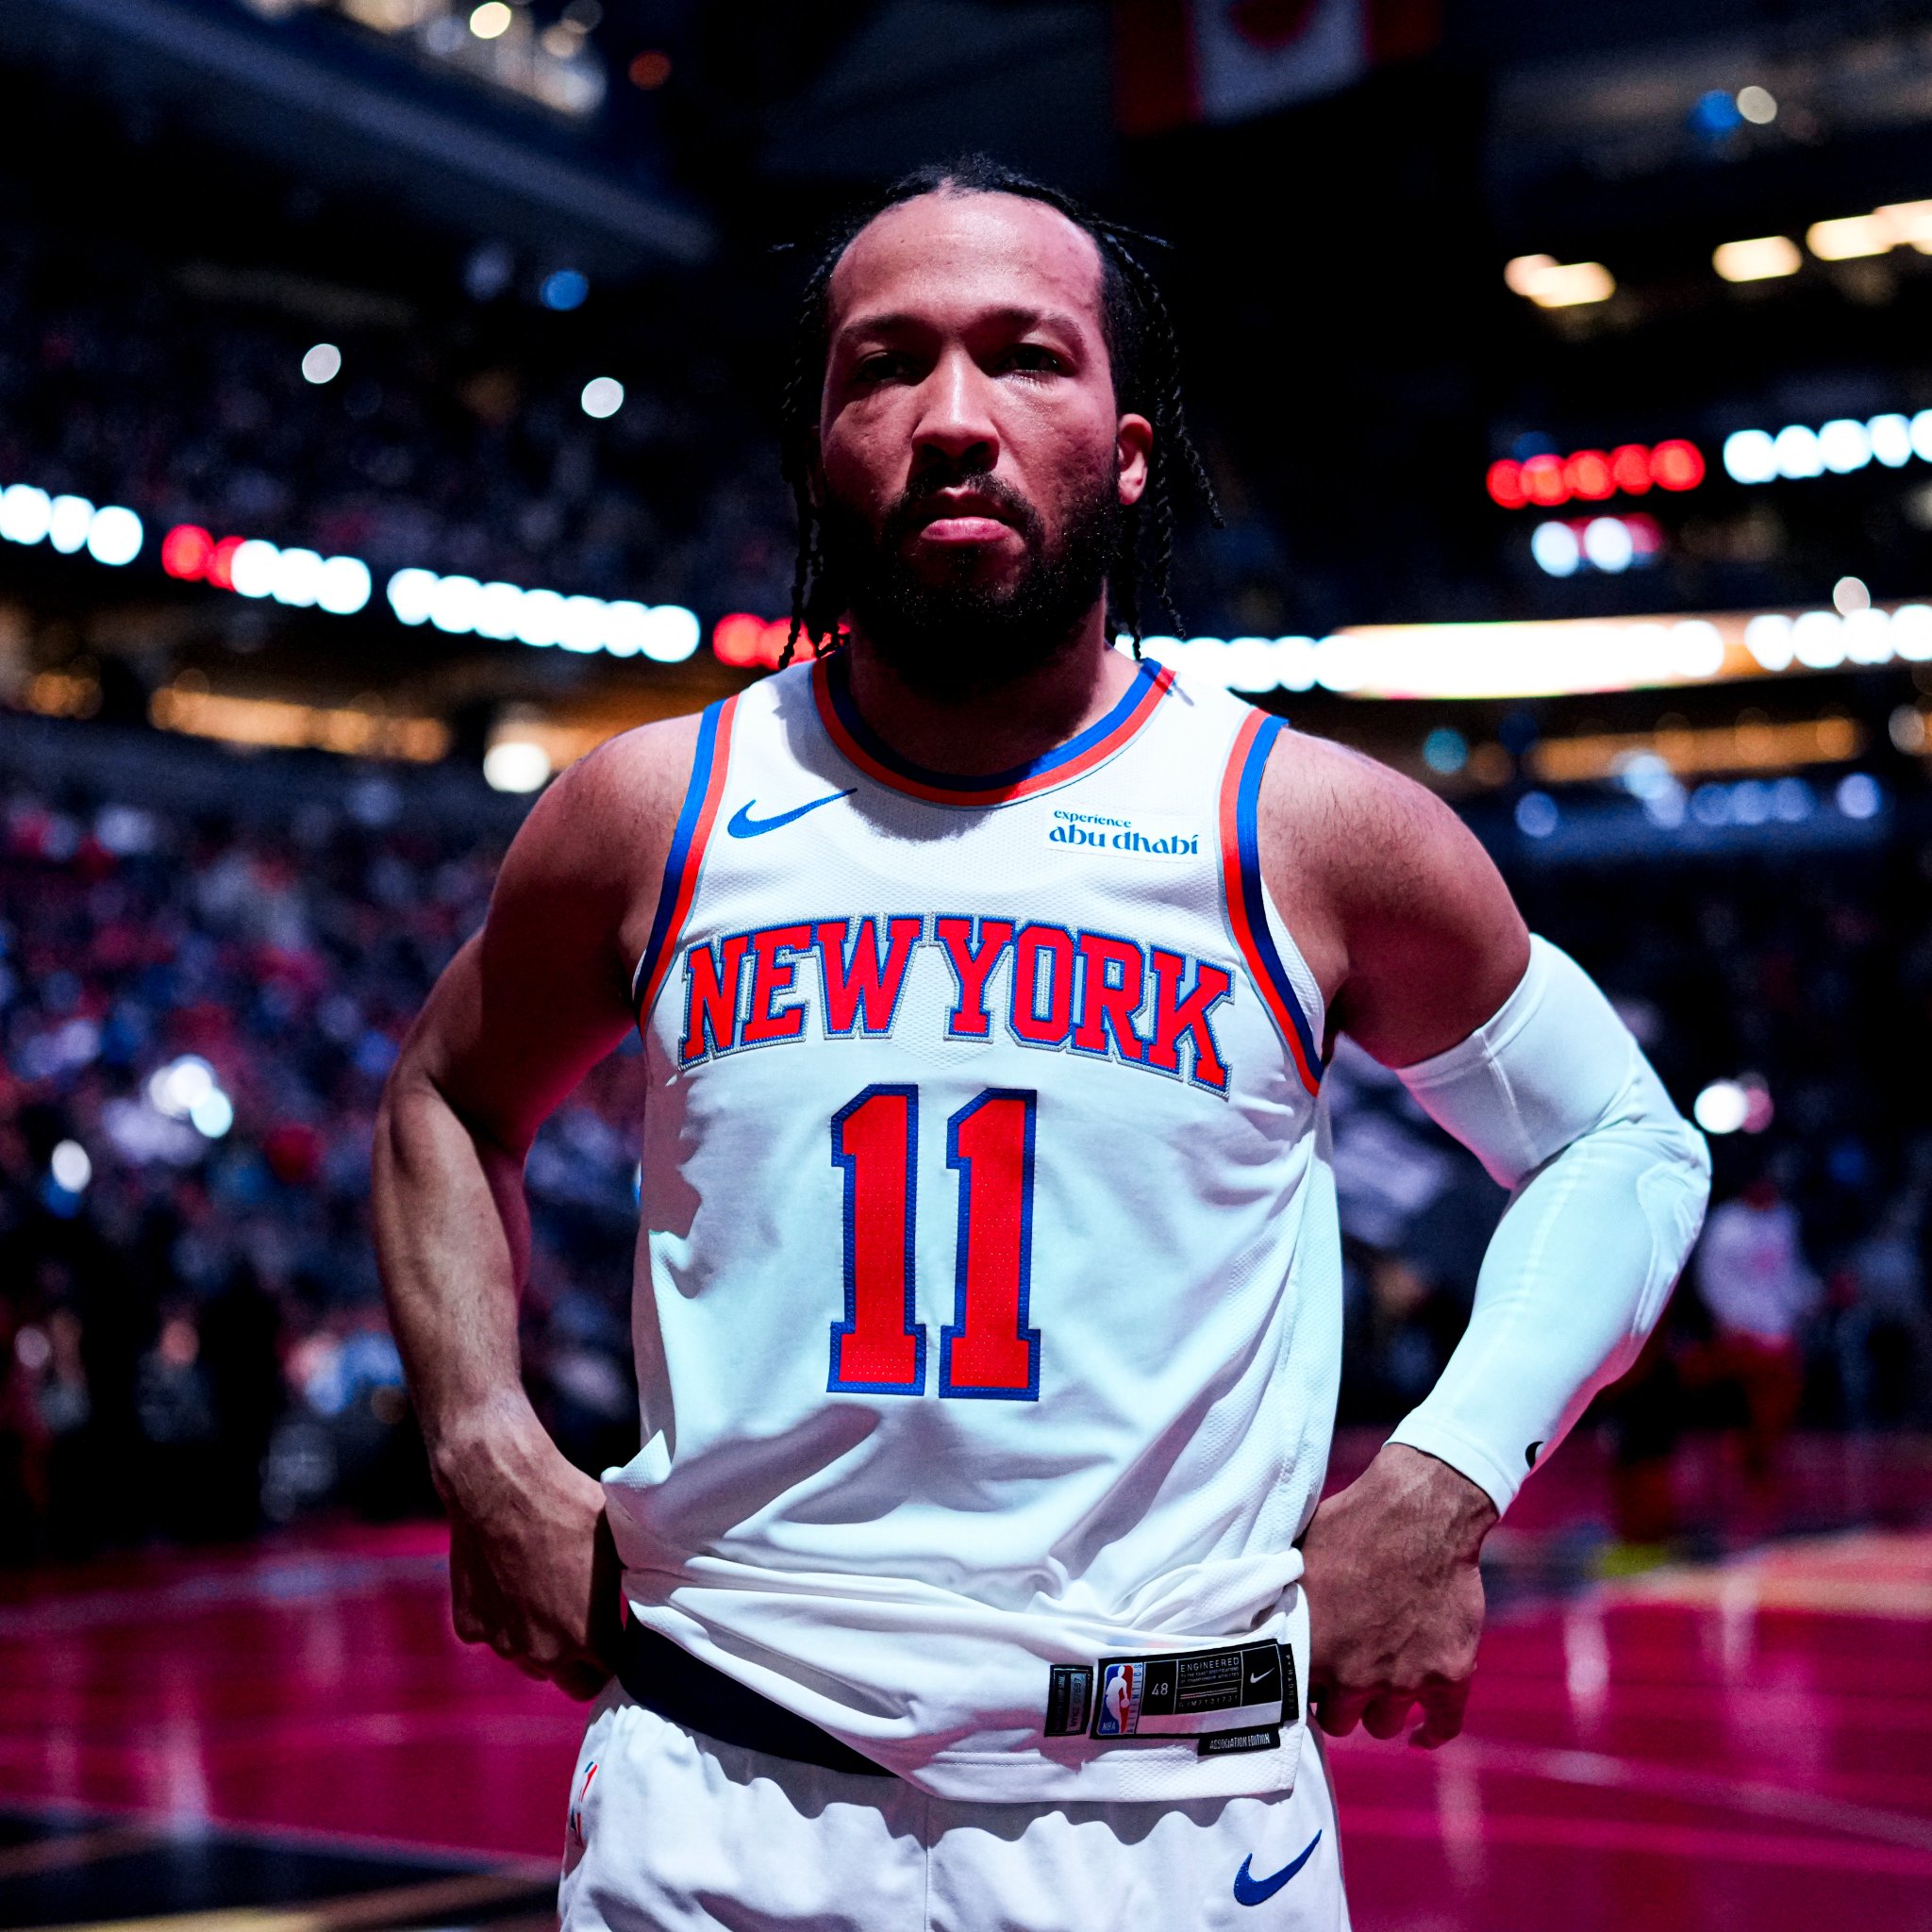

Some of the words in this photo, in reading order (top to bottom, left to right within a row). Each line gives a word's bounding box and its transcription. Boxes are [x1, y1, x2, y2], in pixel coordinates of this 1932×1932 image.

[1053, 808, 1132, 828] experience
[1048, 824, 1106, 848] abu
[677, 911, 925, 1072] NEW
[931, 911, 1236, 1102] YORK
[826, 1083, 1041, 1402] 11
[1180, 1657, 1240, 1673] ENGINEERED
[1151, 1682, 1169, 1696] 48
[1101, 1721, 1117, 1731] NBA
